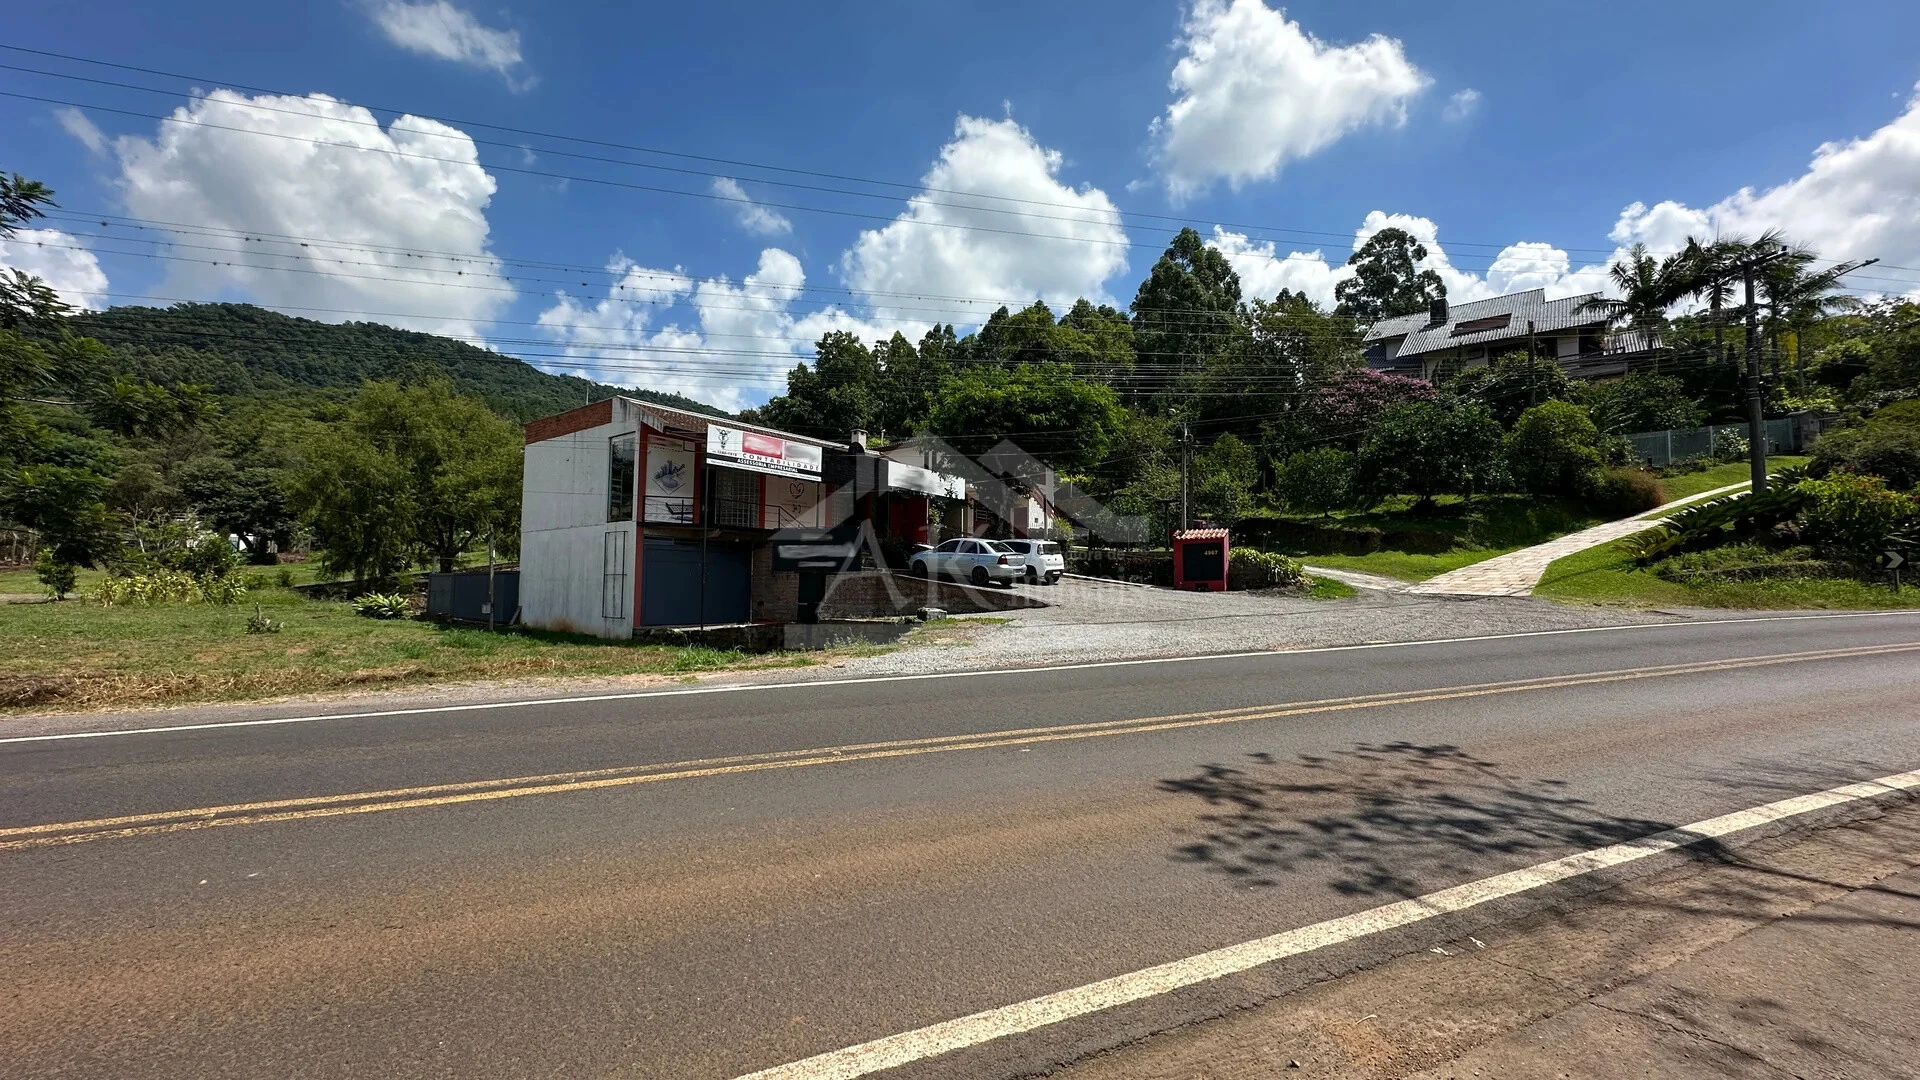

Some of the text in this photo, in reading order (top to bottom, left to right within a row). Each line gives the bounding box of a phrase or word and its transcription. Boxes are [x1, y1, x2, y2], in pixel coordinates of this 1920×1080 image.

[737, 458, 767, 468] ASSESSORIA
[767, 463, 799, 473] EMPRESARIAL
[742, 453, 819, 471] CONTABILIDADE
